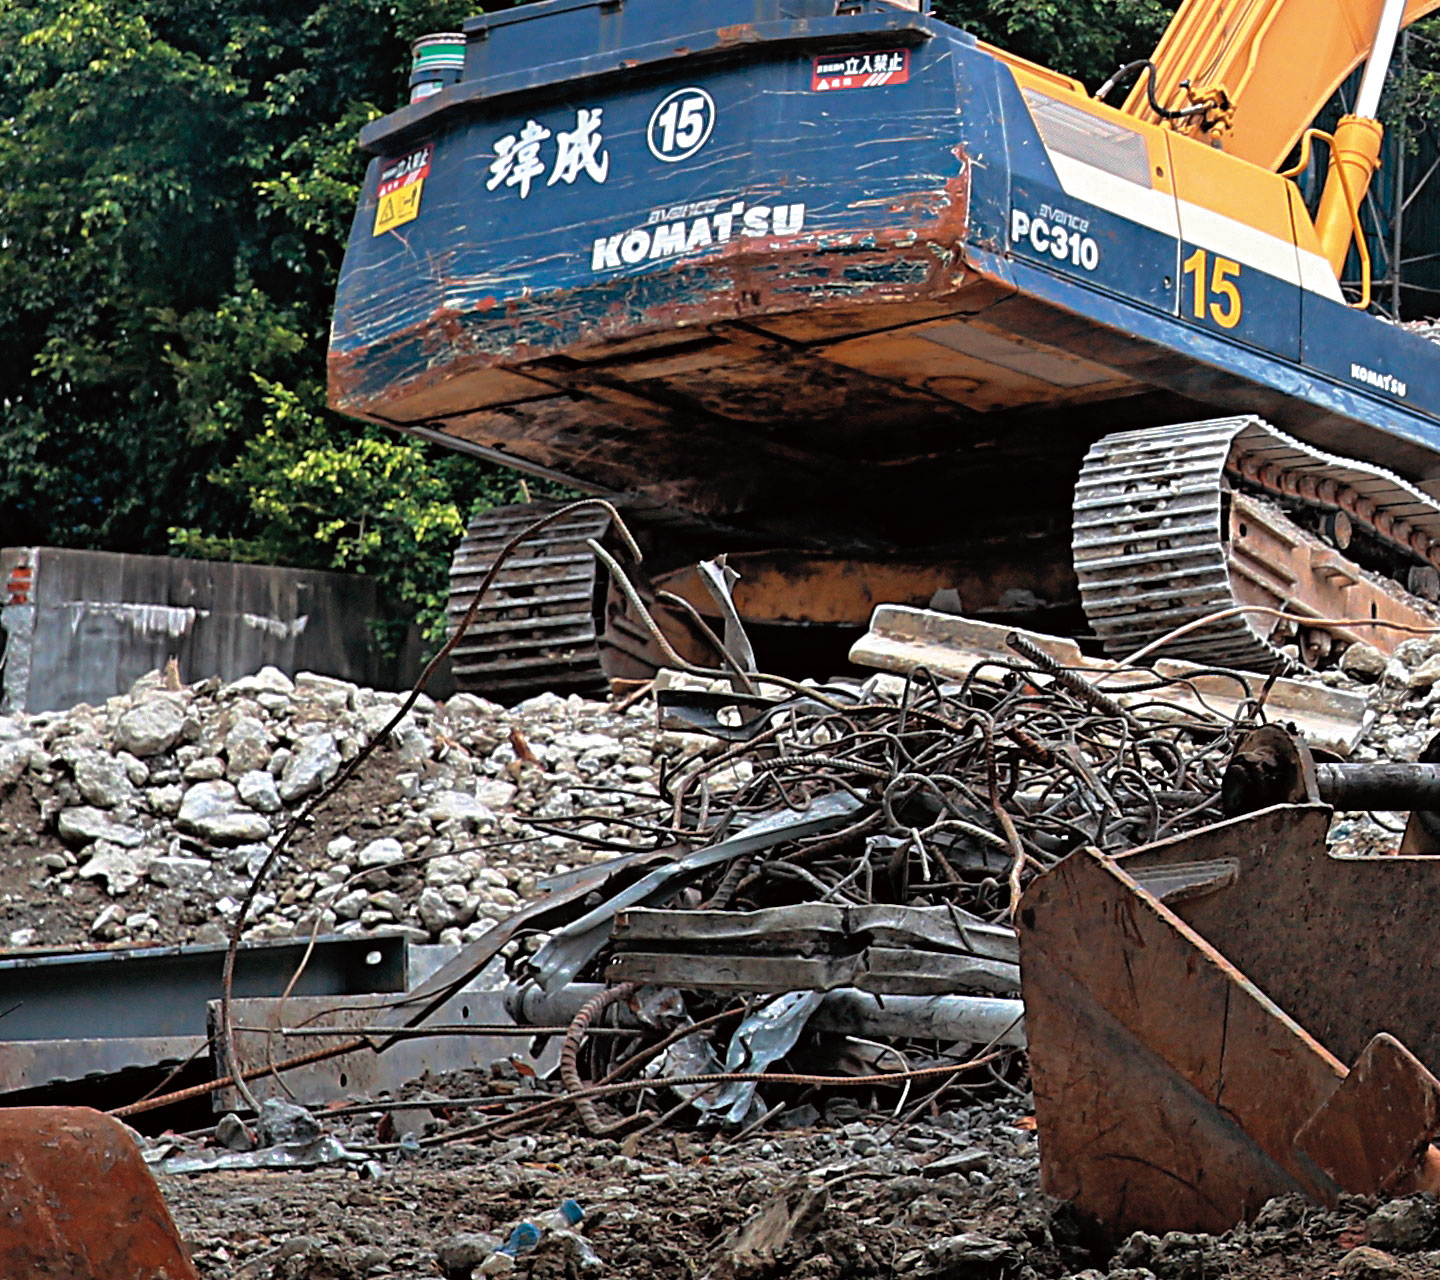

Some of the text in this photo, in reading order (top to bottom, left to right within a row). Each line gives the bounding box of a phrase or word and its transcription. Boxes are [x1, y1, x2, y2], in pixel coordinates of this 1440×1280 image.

[659, 97, 704, 152] 15
[591, 201, 805, 271] KOMATSU
[1012, 209, 1098, 270] PC310
[1040, 204, 1090, 233] avance
[1184, 249, 1241, 328] 15
[1351, 363, 1406, 397] KOMATSU
